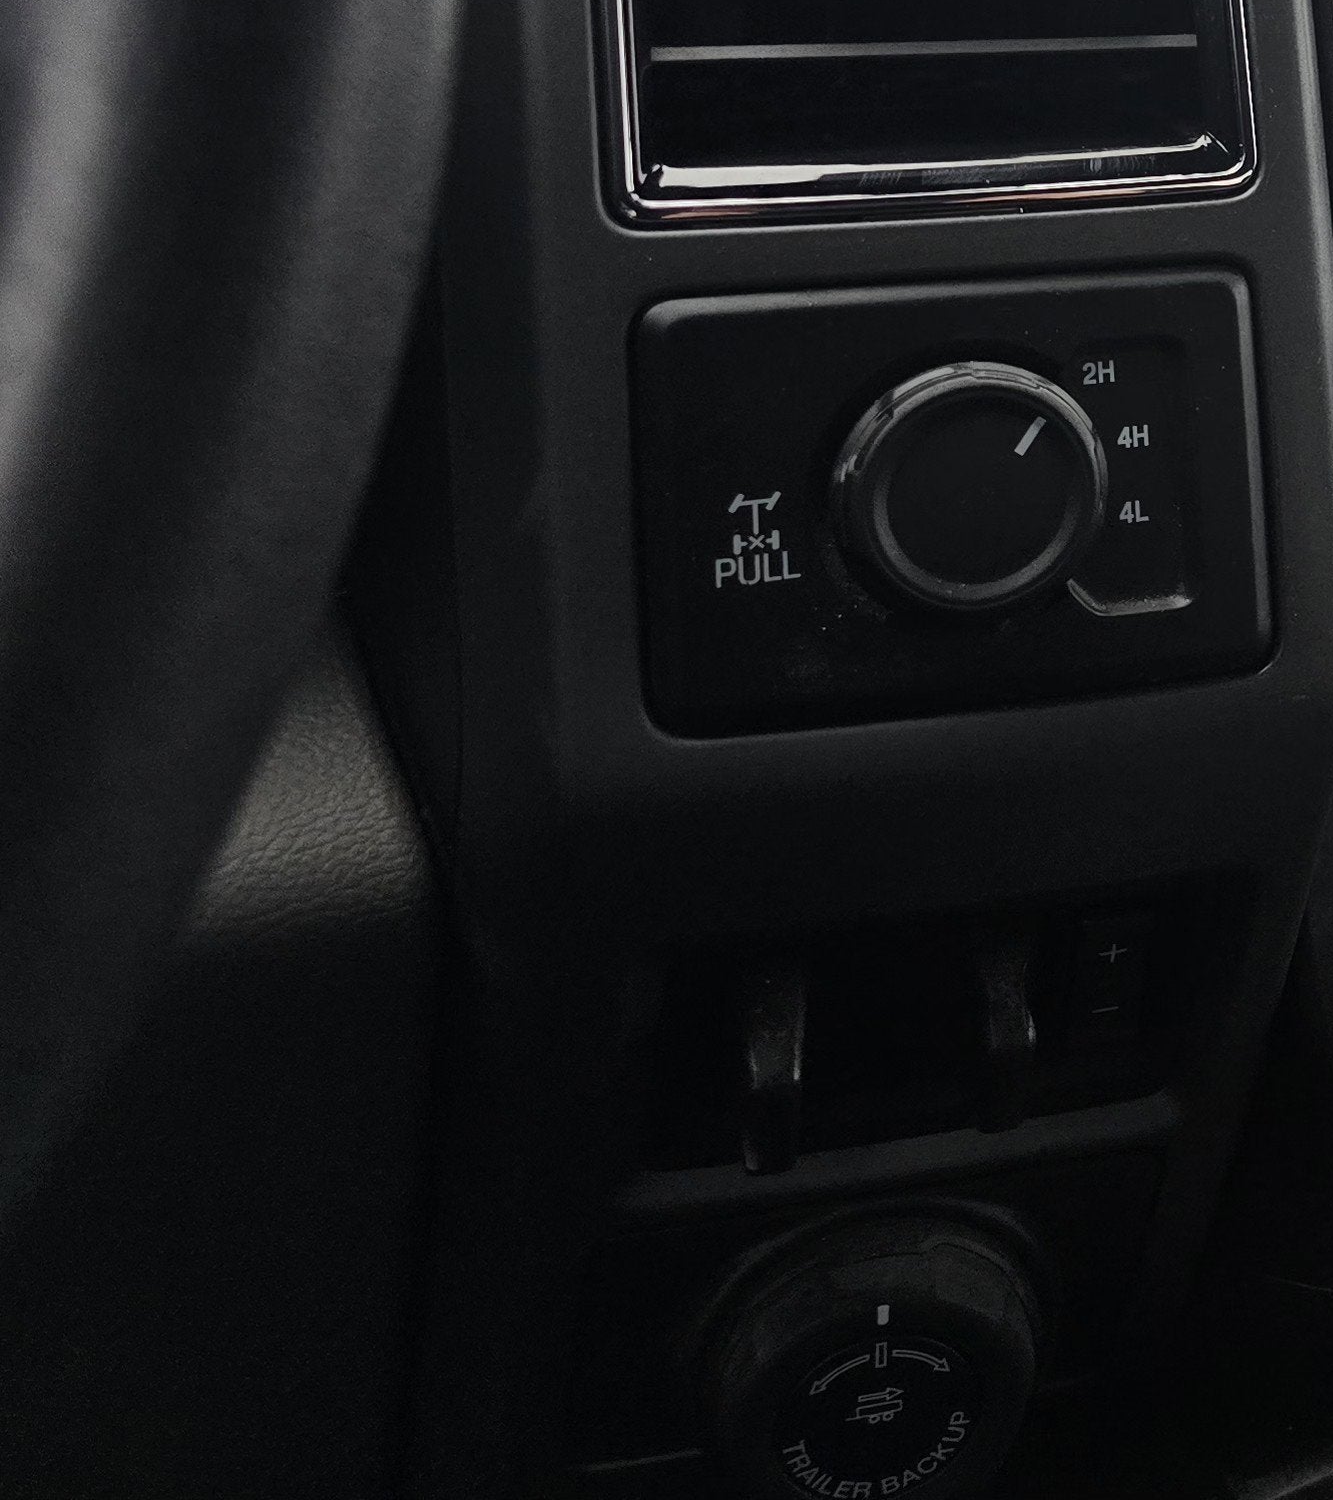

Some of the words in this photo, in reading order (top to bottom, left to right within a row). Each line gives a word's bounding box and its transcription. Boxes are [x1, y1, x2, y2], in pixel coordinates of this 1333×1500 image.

[1082, 360, 1116, 385] 2H
[1117, 424, 1150, 450] 4H
[1119, 500, 1149, 524] 4L
[714, 550, 802, 589] PULL
[782, 1439, 873, 1500] TRAILER
